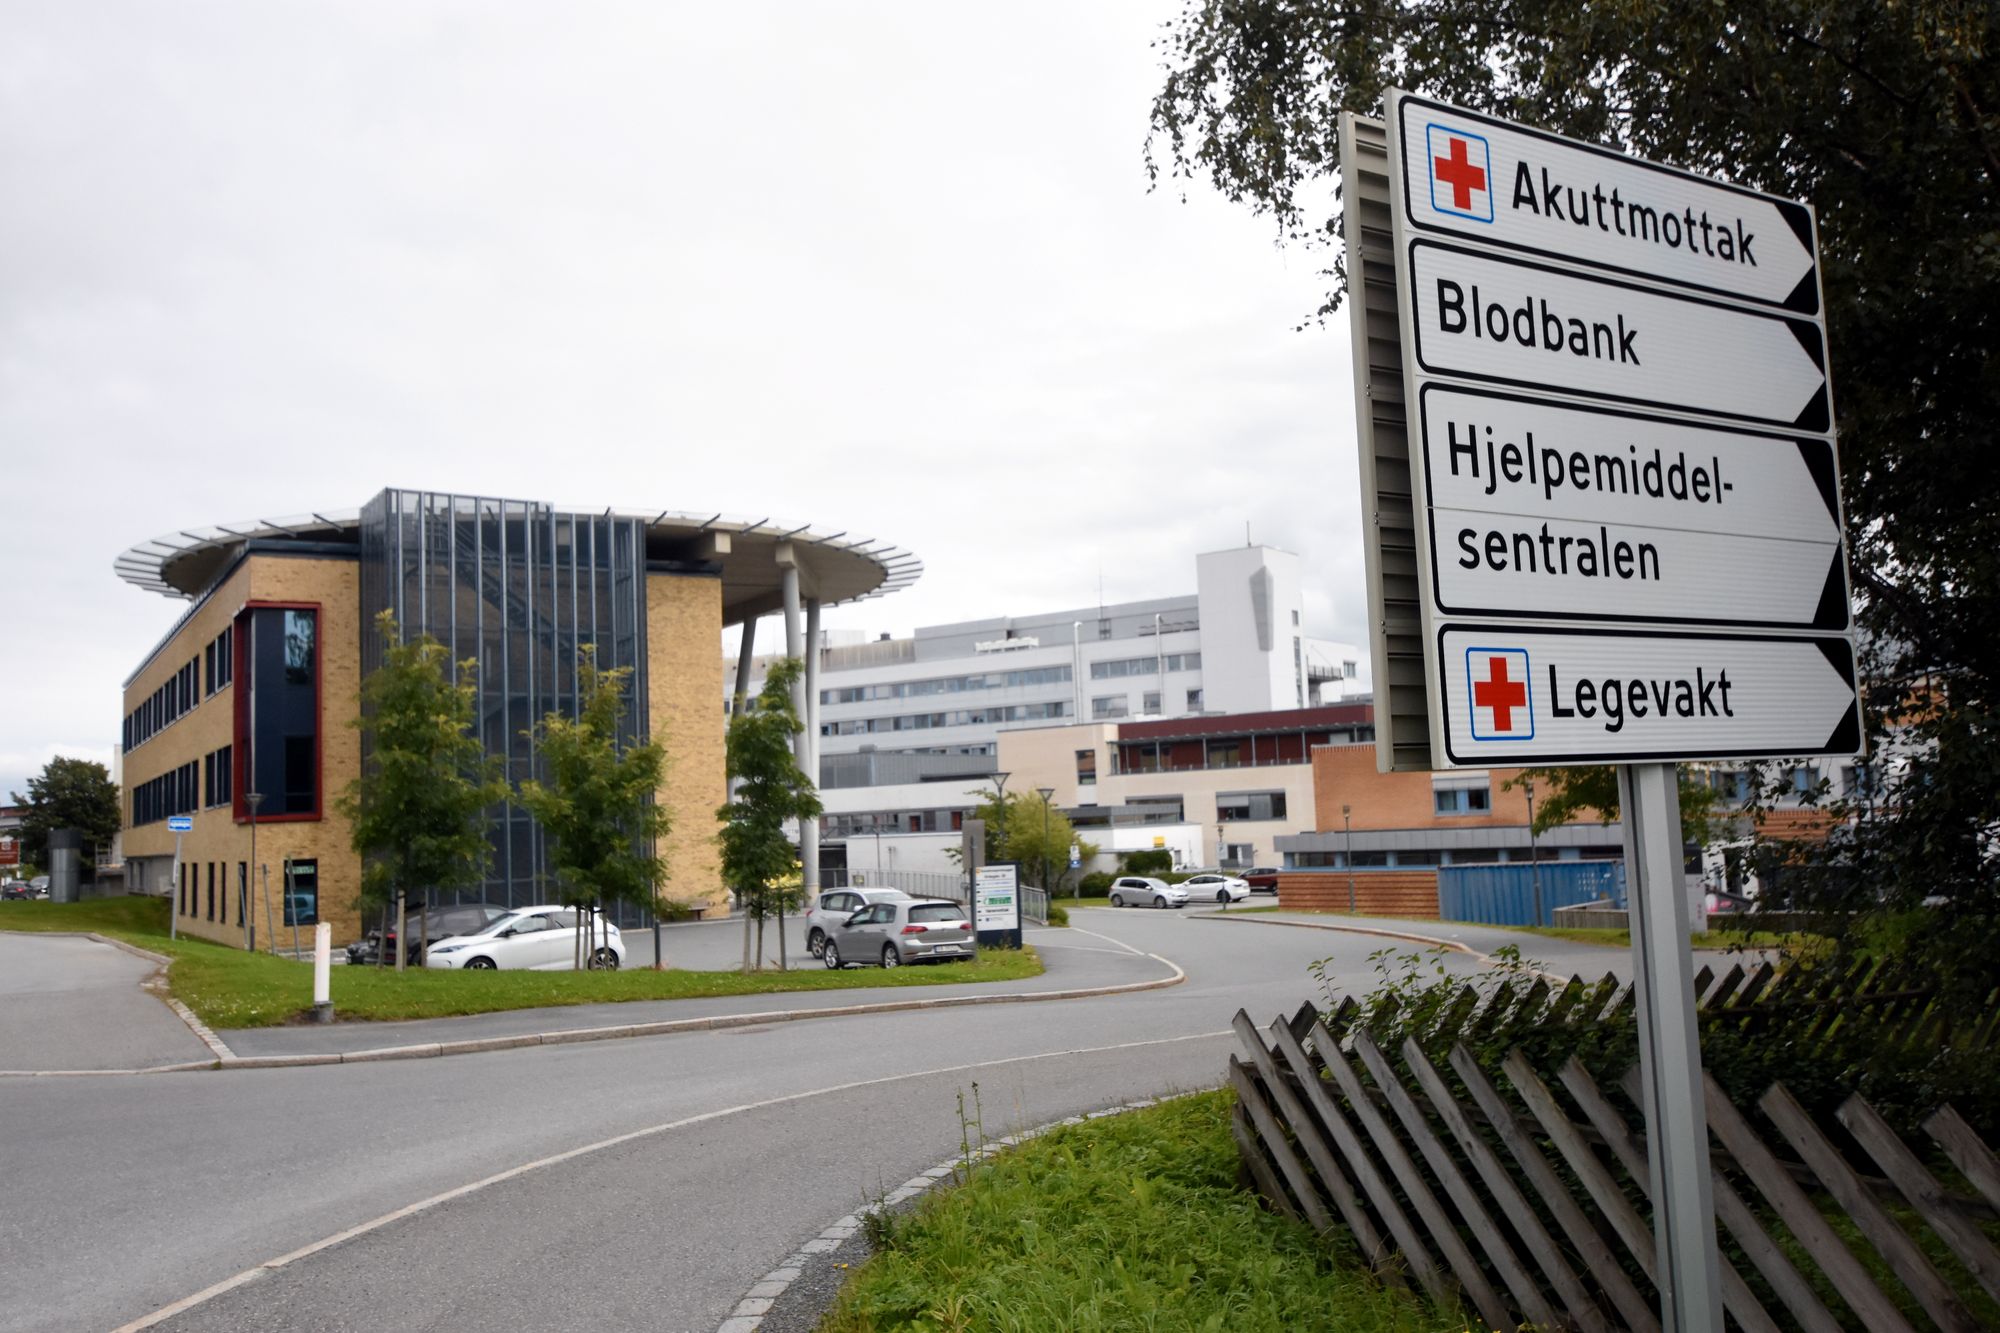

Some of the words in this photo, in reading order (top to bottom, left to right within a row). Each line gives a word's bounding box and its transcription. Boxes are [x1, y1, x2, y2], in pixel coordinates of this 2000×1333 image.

[1512, 160, 1757, 267] Akuttmottak
[1436, 278, 1641, 366] Blodbank
[1447, 421, 1733, 505] Hjelpemiddel-
[1457, 522, 1660, 581] sentralen
[1548, 664, 1734, 733] Legevakt
